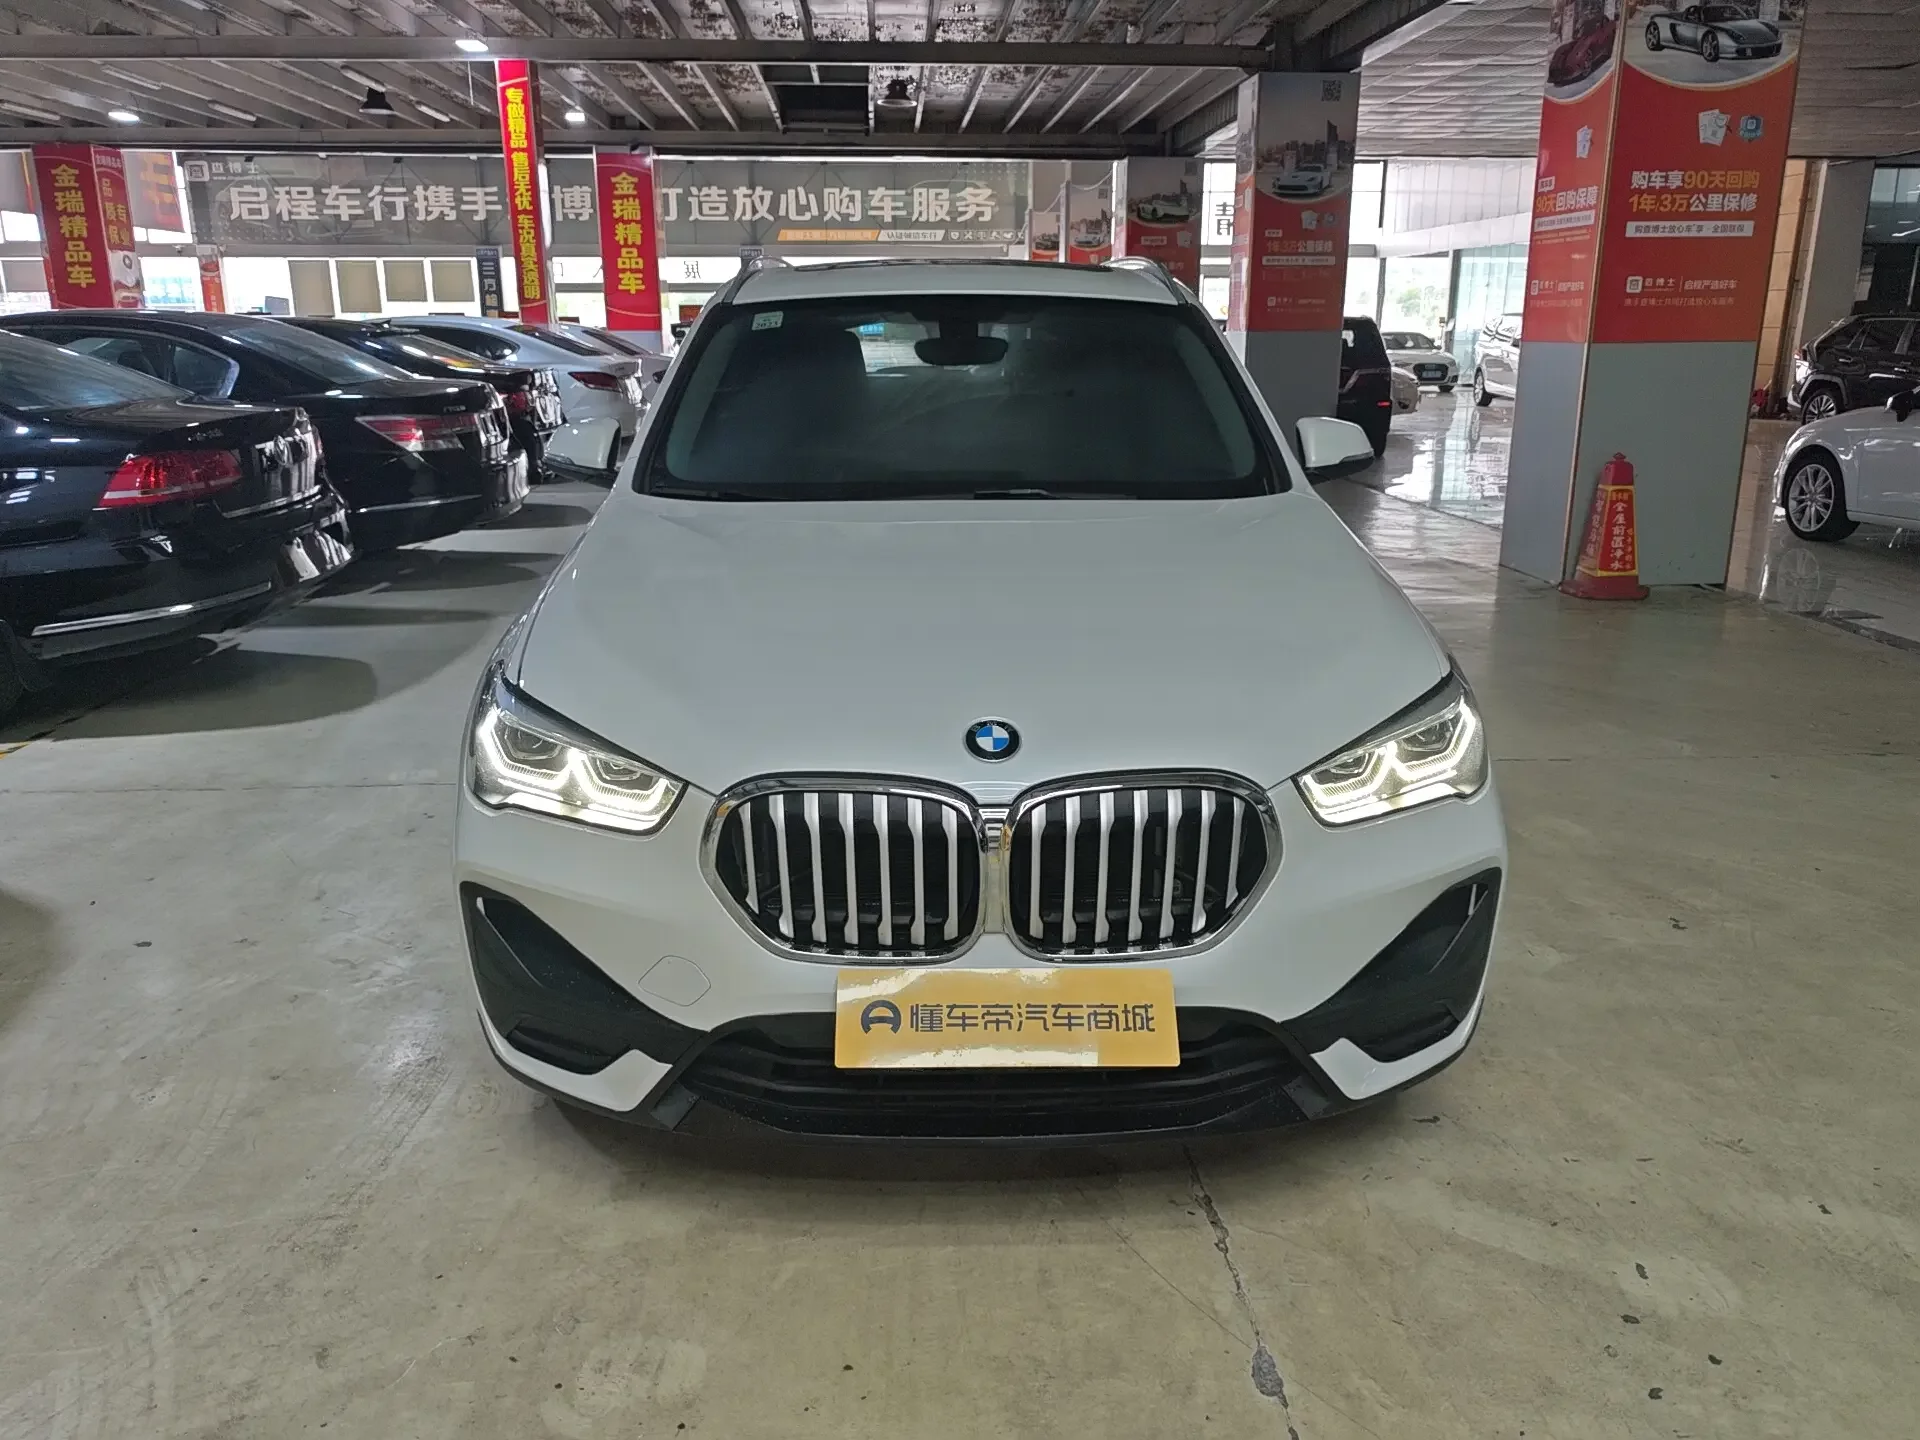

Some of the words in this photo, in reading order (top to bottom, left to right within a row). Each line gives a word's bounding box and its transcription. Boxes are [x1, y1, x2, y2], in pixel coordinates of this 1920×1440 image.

[511, 151, 533, 210] 售后无忧
[1630, 169, 1761, 190] 购车享90天回购
[51, 163, 97, 289] 金瑞精品车
[517, 214, 541, 300] 车况真实透明
[610, 171, 646, 295] 金瑞精品车
[1610, 502, 1629, 571] 全屋前置净水
